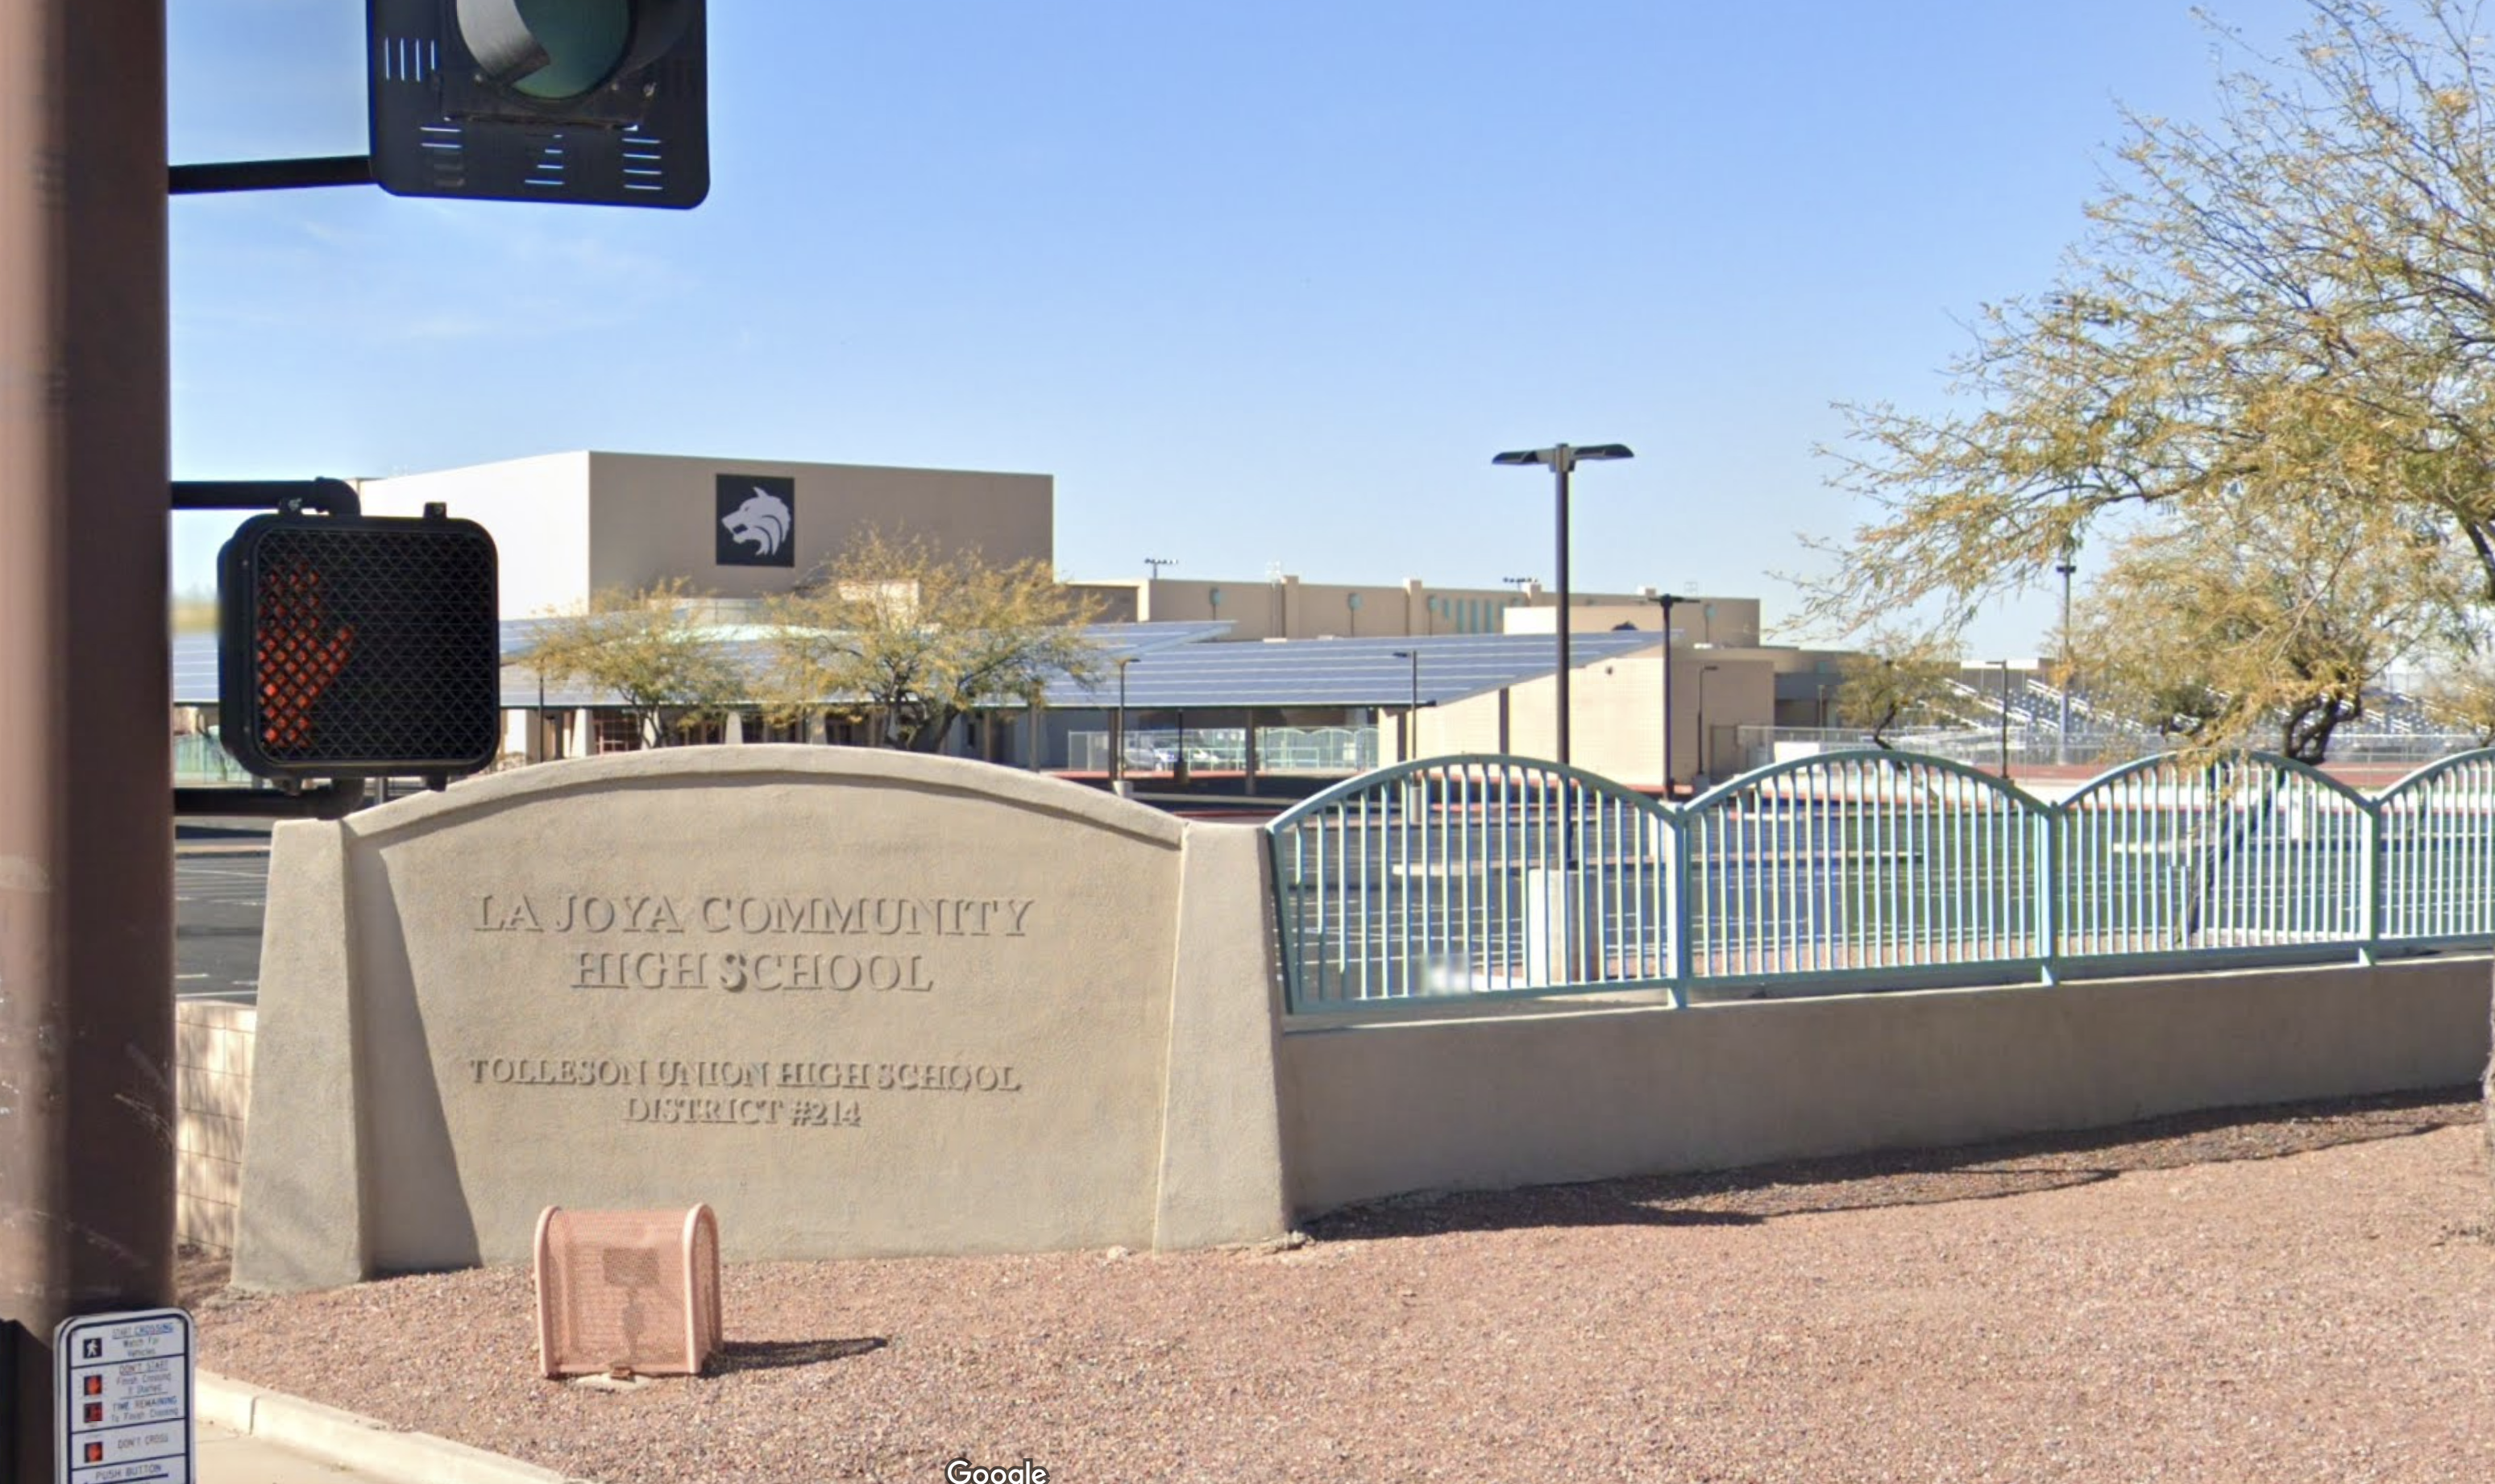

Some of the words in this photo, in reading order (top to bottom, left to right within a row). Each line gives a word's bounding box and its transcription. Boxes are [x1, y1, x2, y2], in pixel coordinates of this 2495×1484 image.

[474, 894, 544, 932] LA
[557, 894, 684, 933] JOYA
[701, 896, 1034, 937] COMMUNITY
[570, 951, 708, 990] HIGH
[720, 952, 934, 993] SCHOOL
[469, 1058, 646, 1086] TOLLESON
[658, 1059, 770, 1088] UNION
[776, 1060, 870, 1088] HIGH
[878, 1062, 1023, 1091] SCHOOL
[622, 1096, 783, 1125] DISTRICT
[790, 1099, 861, 1127] #214
[135, 1395, 177, 1409] REMAINING
[95, 1469, 122, 1481] PUSH
[125, 1463, 162, 1477] BUTTON
